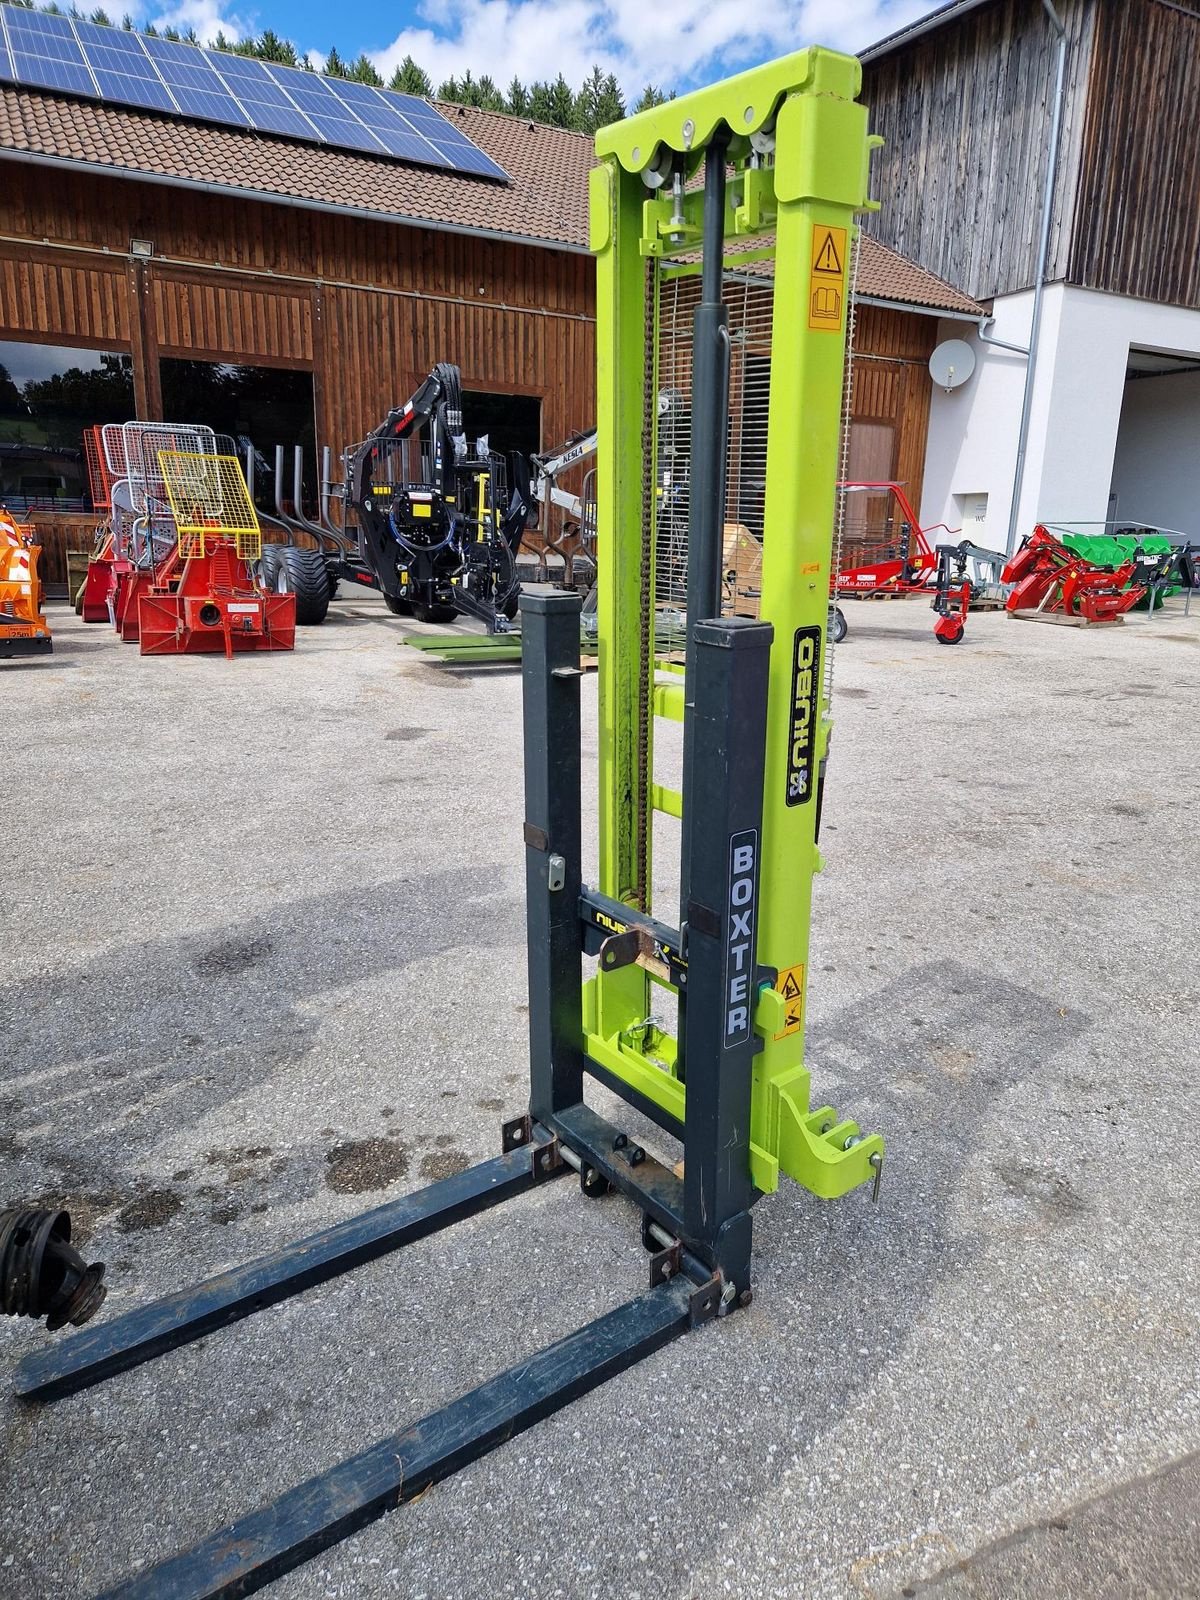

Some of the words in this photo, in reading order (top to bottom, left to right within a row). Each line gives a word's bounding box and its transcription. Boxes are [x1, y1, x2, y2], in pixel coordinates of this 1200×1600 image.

[562, 446, 583, 463] KESLA
[792, 636, 813, 768] NIUBO
[596, 912, 627, 934] NIUB
[727, 845, 753, 1035] BOXTER
